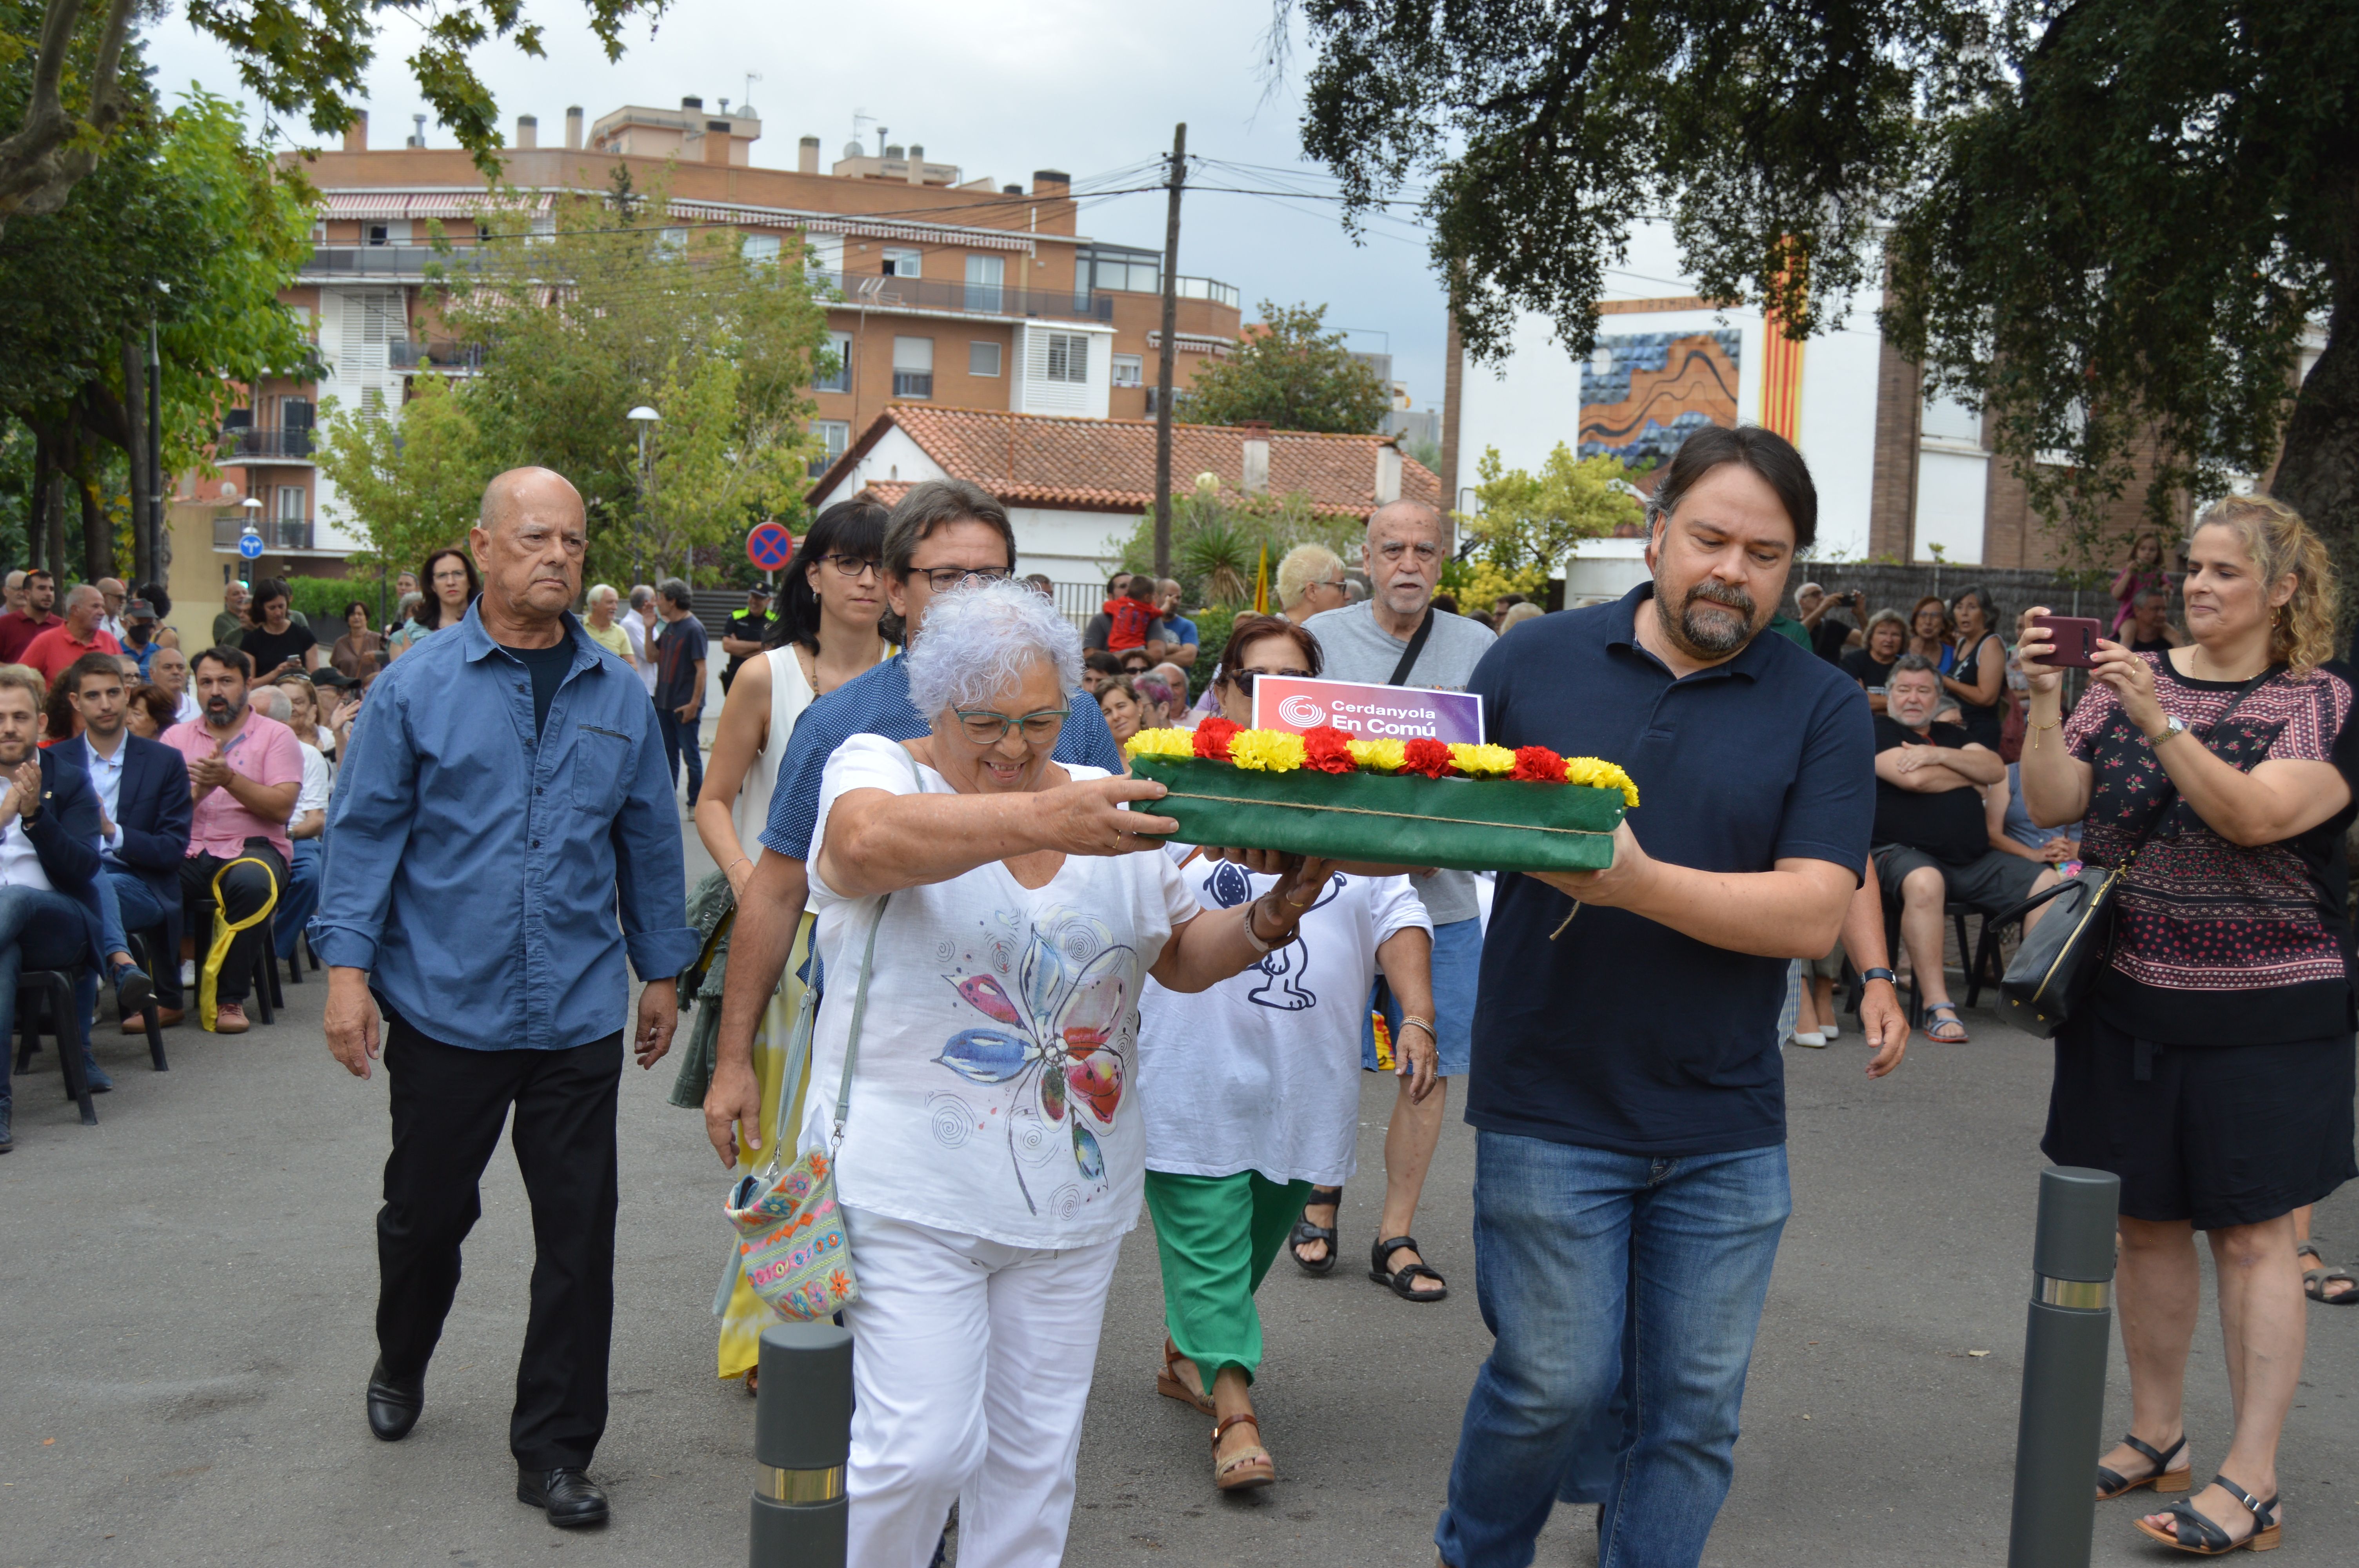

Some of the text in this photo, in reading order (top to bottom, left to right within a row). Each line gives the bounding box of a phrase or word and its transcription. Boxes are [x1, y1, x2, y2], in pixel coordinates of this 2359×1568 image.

[1331, 700, 1436, 719] Cerdanyola
[1332, 714, 1436, 737] En Comú
